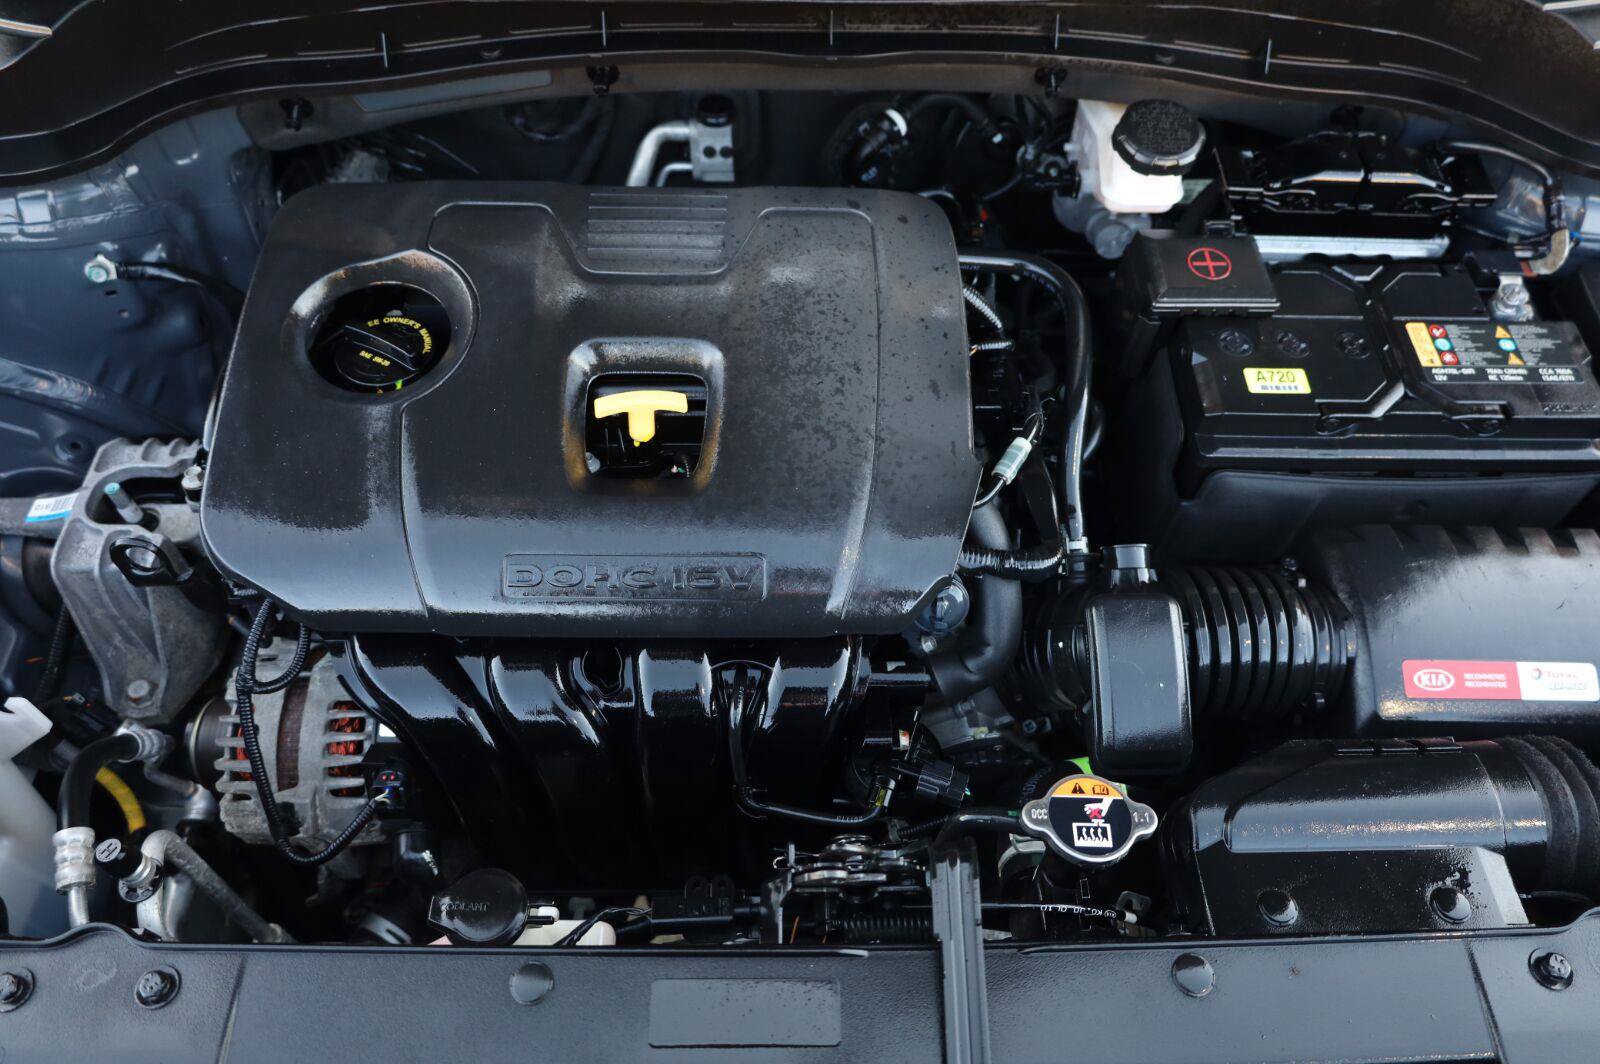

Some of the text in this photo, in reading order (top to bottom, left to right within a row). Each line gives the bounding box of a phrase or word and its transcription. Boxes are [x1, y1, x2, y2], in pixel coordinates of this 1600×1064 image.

[383, 317, 422, 330] OWNER'S
[418, 327, 433, 355] MANUAL
[1257, 370, 1296, 383] A720
[507, 563, 760, 590] DOHC 16V
